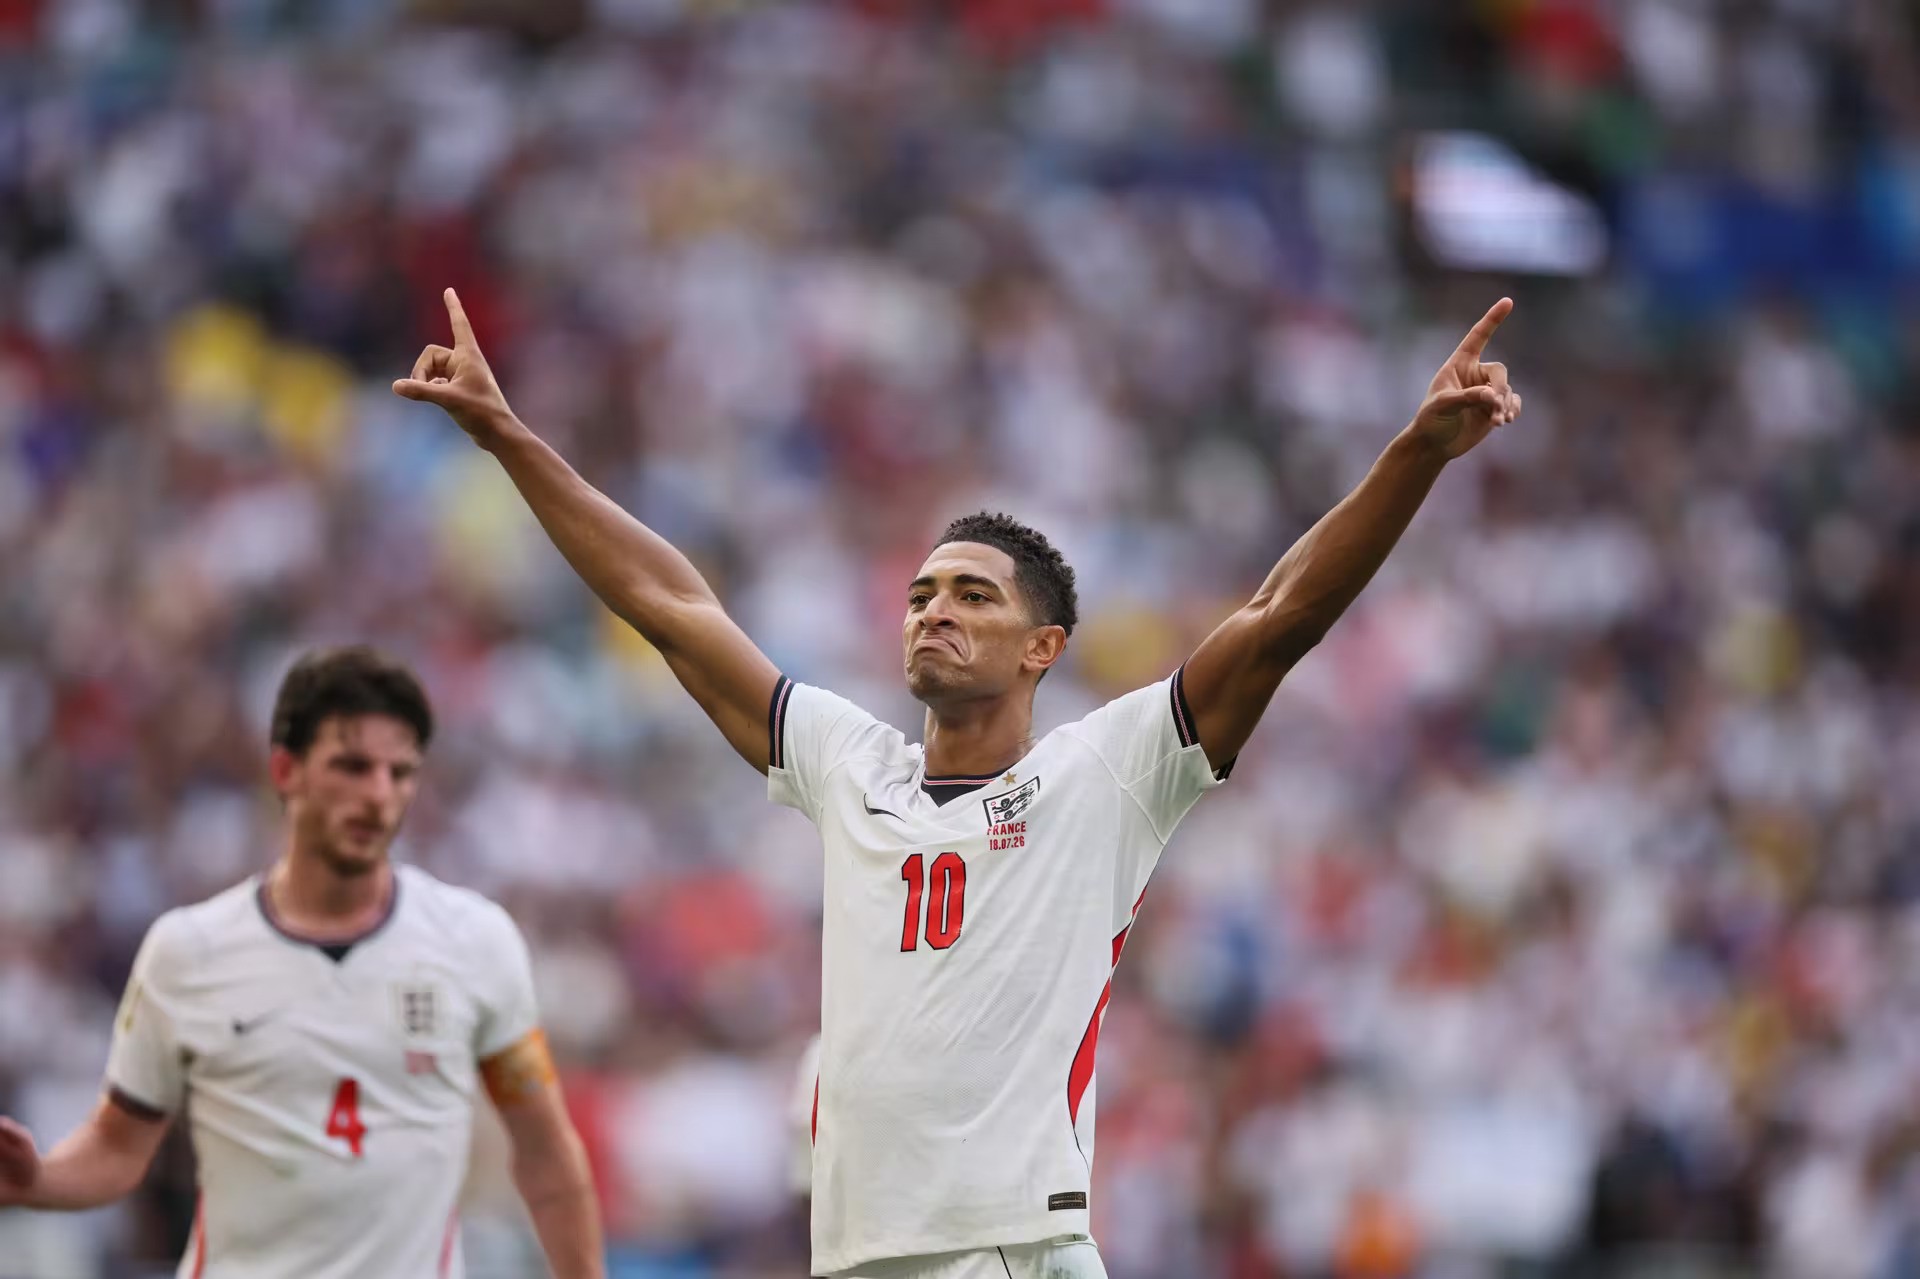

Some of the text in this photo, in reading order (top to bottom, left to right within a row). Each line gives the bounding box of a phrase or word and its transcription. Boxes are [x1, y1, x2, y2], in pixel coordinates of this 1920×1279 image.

[989, 836, 1025, 851] 18.07.26
[901, 852, 966, 952] 10
[325, 1077, 369, 1158] 4
